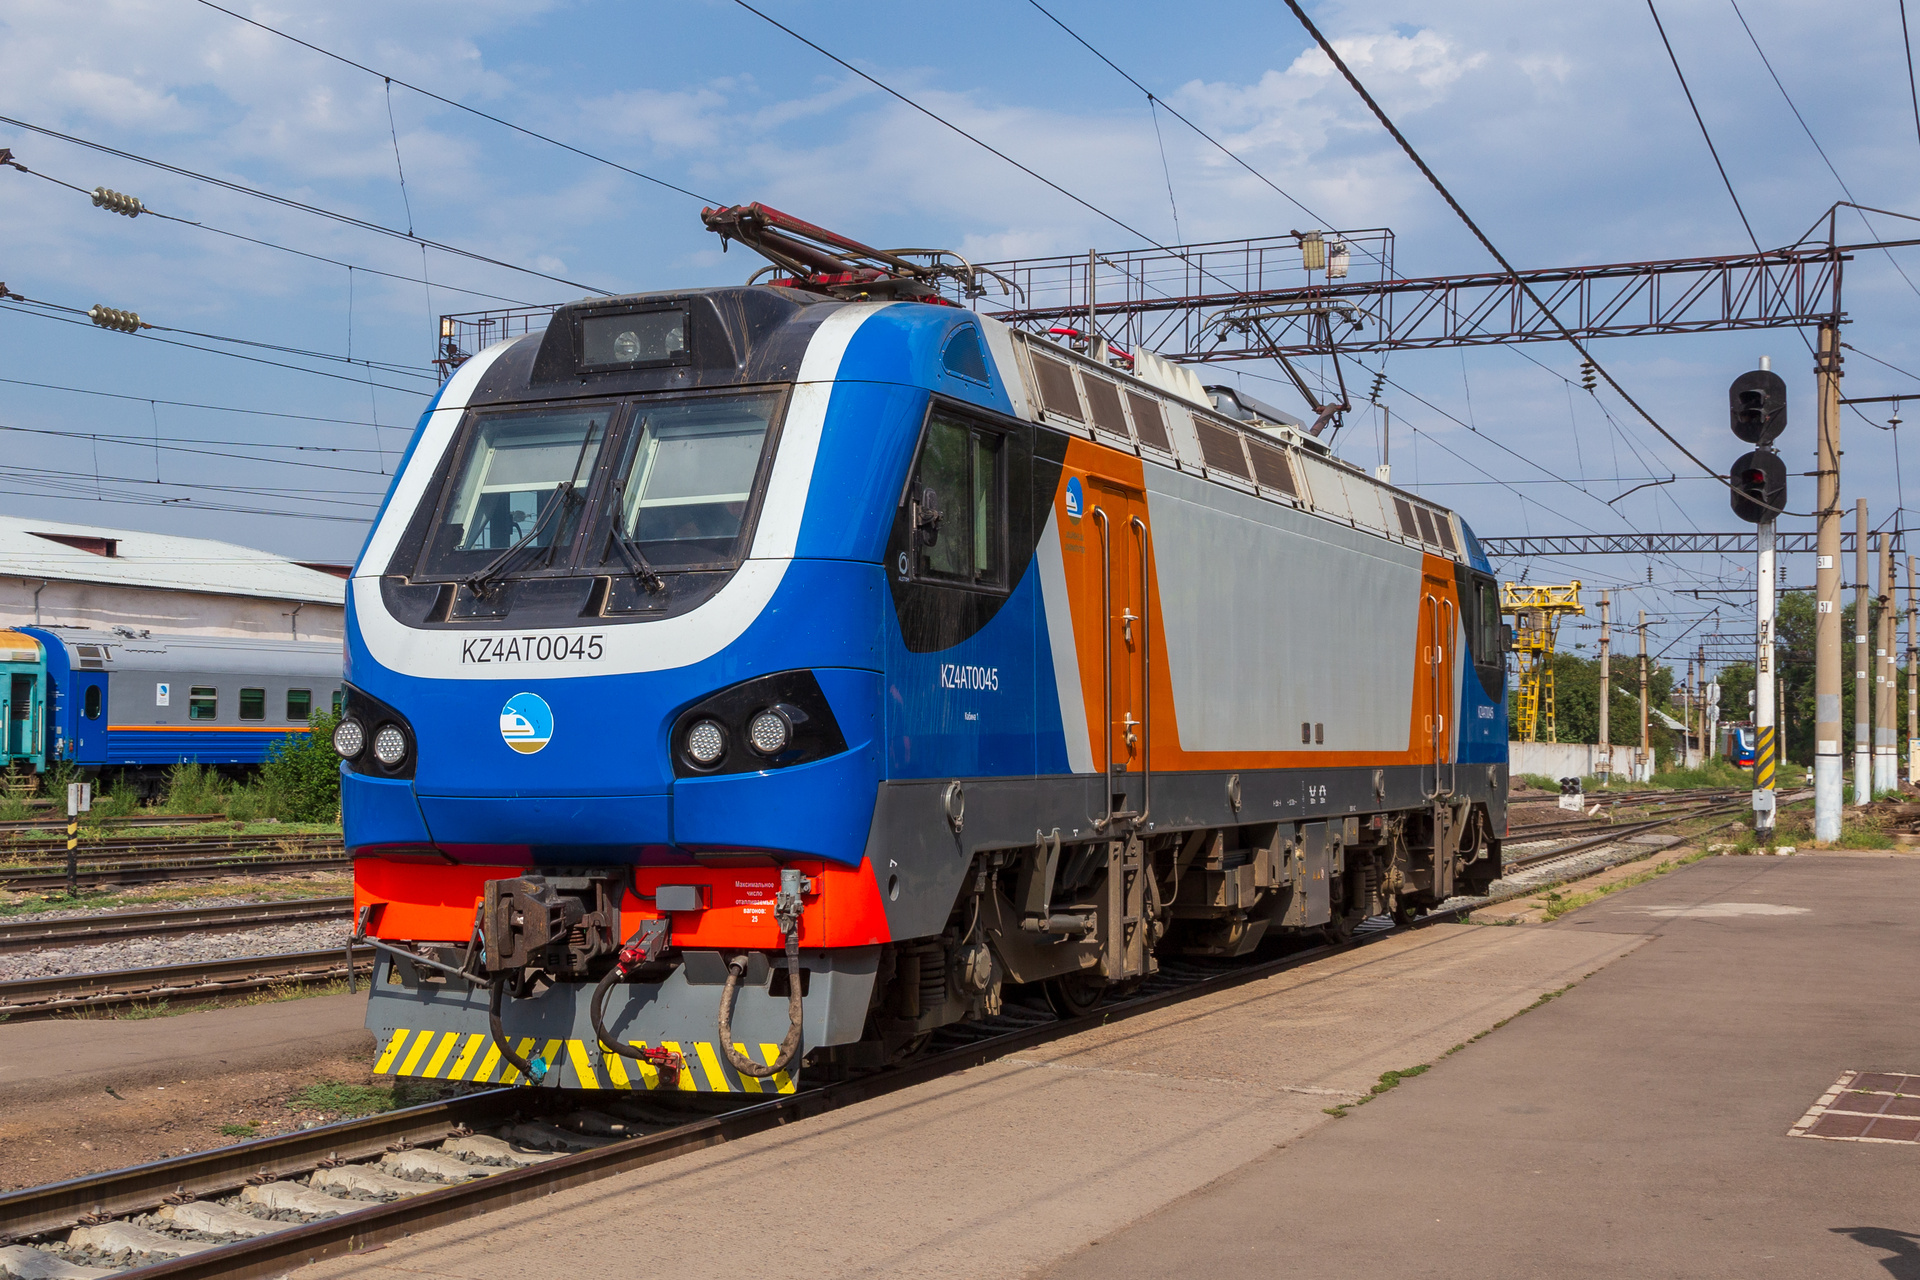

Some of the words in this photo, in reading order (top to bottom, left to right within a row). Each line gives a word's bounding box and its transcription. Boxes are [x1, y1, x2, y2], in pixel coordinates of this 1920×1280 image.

[1820, 602, 1828, 612] 51
[462, 635, 603, 663] KZ4AT0045
[941, 664, 999, 691] KZ4AT0045
[735, 880, 774, 888] Максимальное
[751, 915, 759, 923] 25
